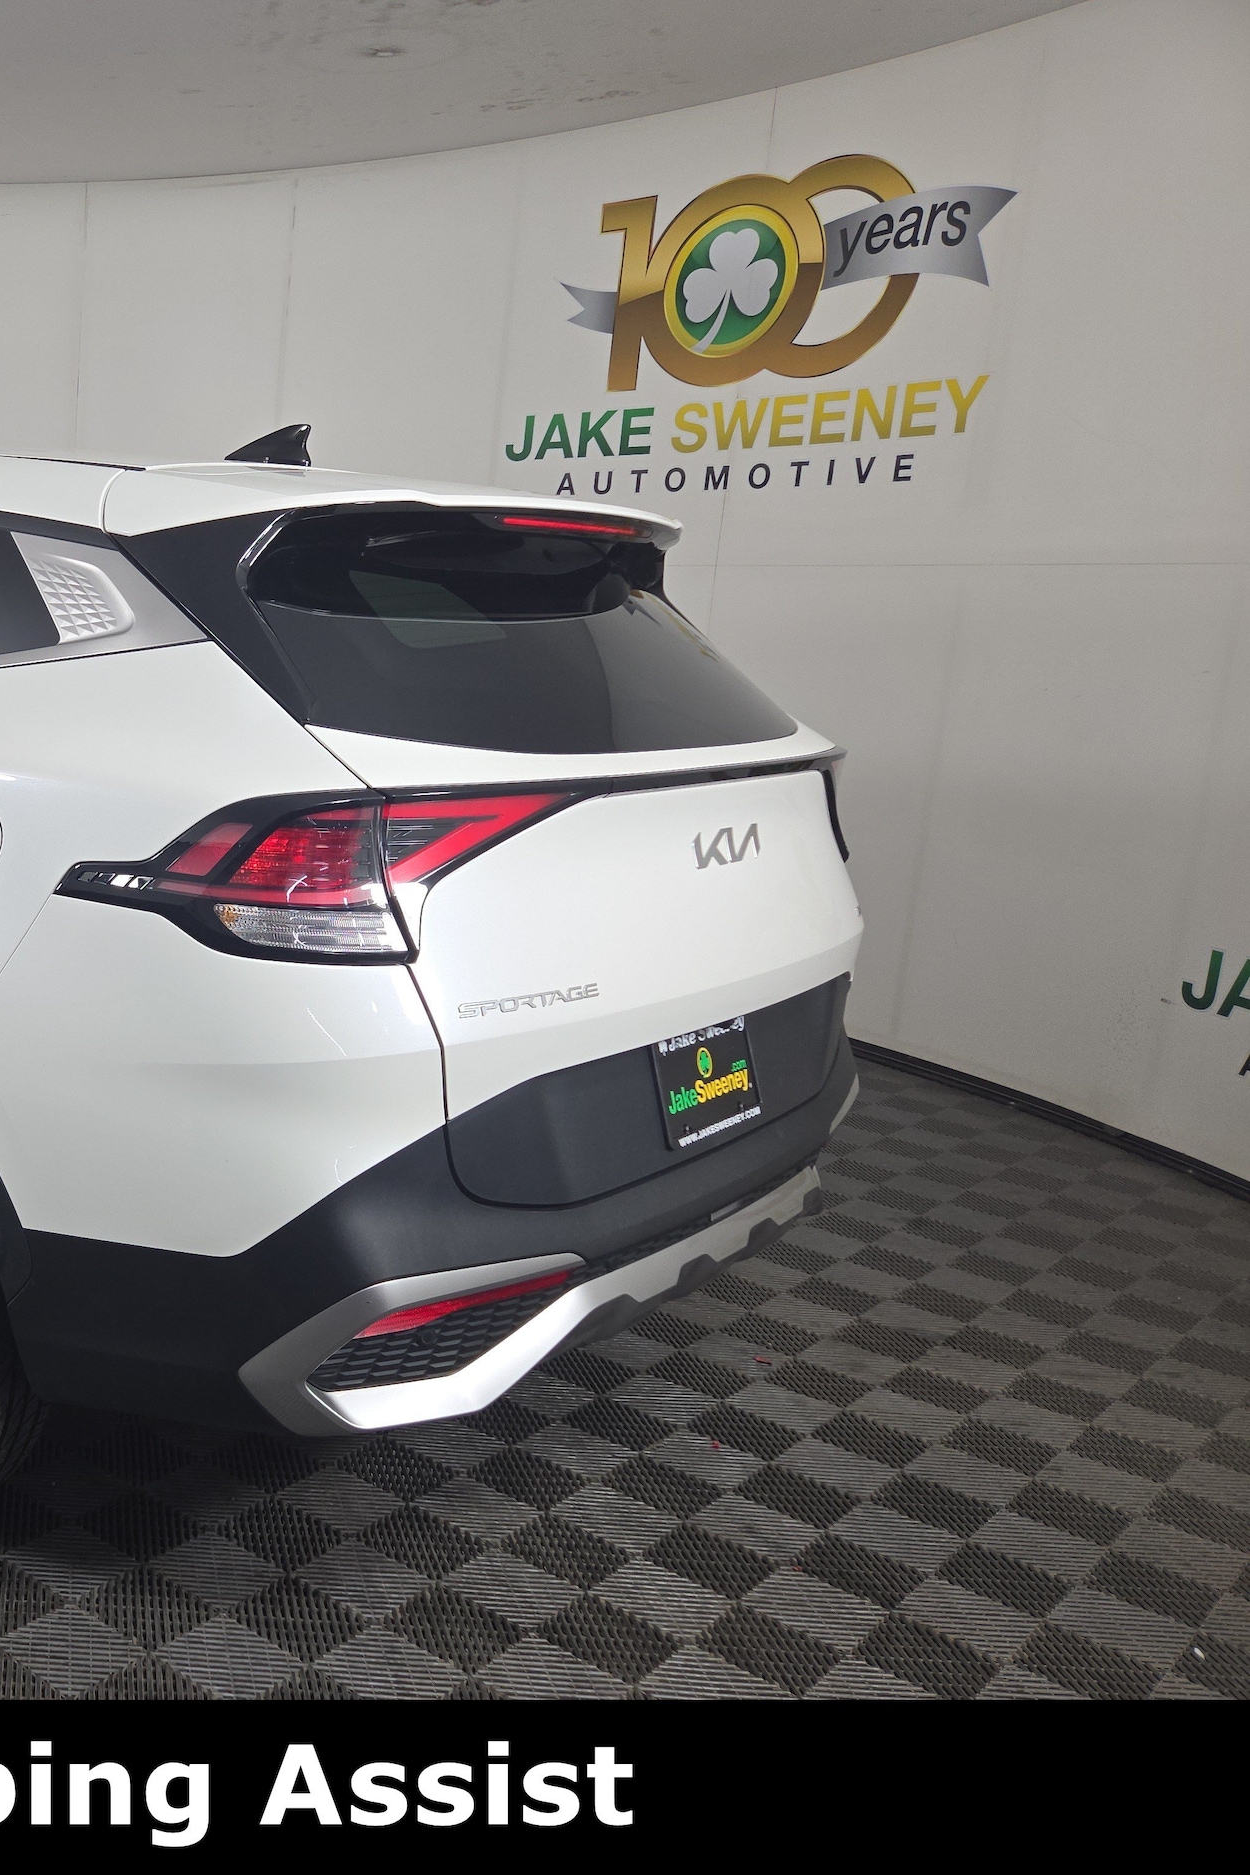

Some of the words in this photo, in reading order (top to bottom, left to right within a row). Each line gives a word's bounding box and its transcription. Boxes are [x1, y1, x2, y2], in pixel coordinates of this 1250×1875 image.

[833, 201, 971, 277] years
[601, 154, 920, 393] 100
[505, 407, 655, 462] JAKE
[671, 375, 991, 454] SWEENEY
[556, 454, 914, 496] AUTOMOTIVE
[457, 983, 600, 1019] SPORTAGE
[731, 1059, 748, 1072] .com
